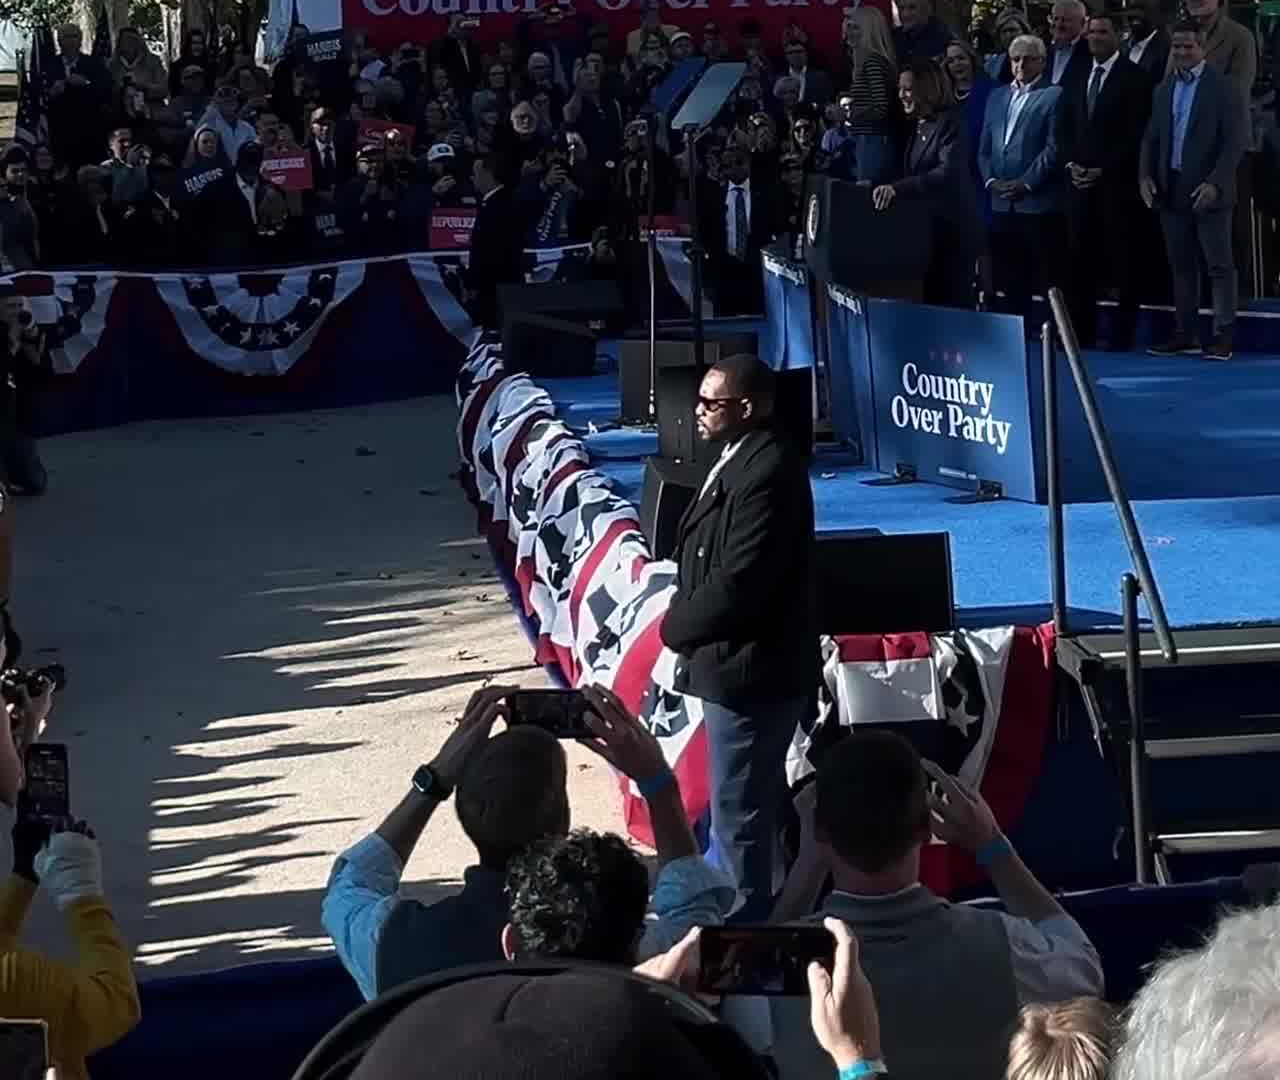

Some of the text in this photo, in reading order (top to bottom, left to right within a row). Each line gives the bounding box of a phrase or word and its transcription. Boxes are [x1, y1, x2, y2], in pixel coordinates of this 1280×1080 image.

[902, 362, 995, 416] Country
[891, 395, 1012, 455] Over Party
